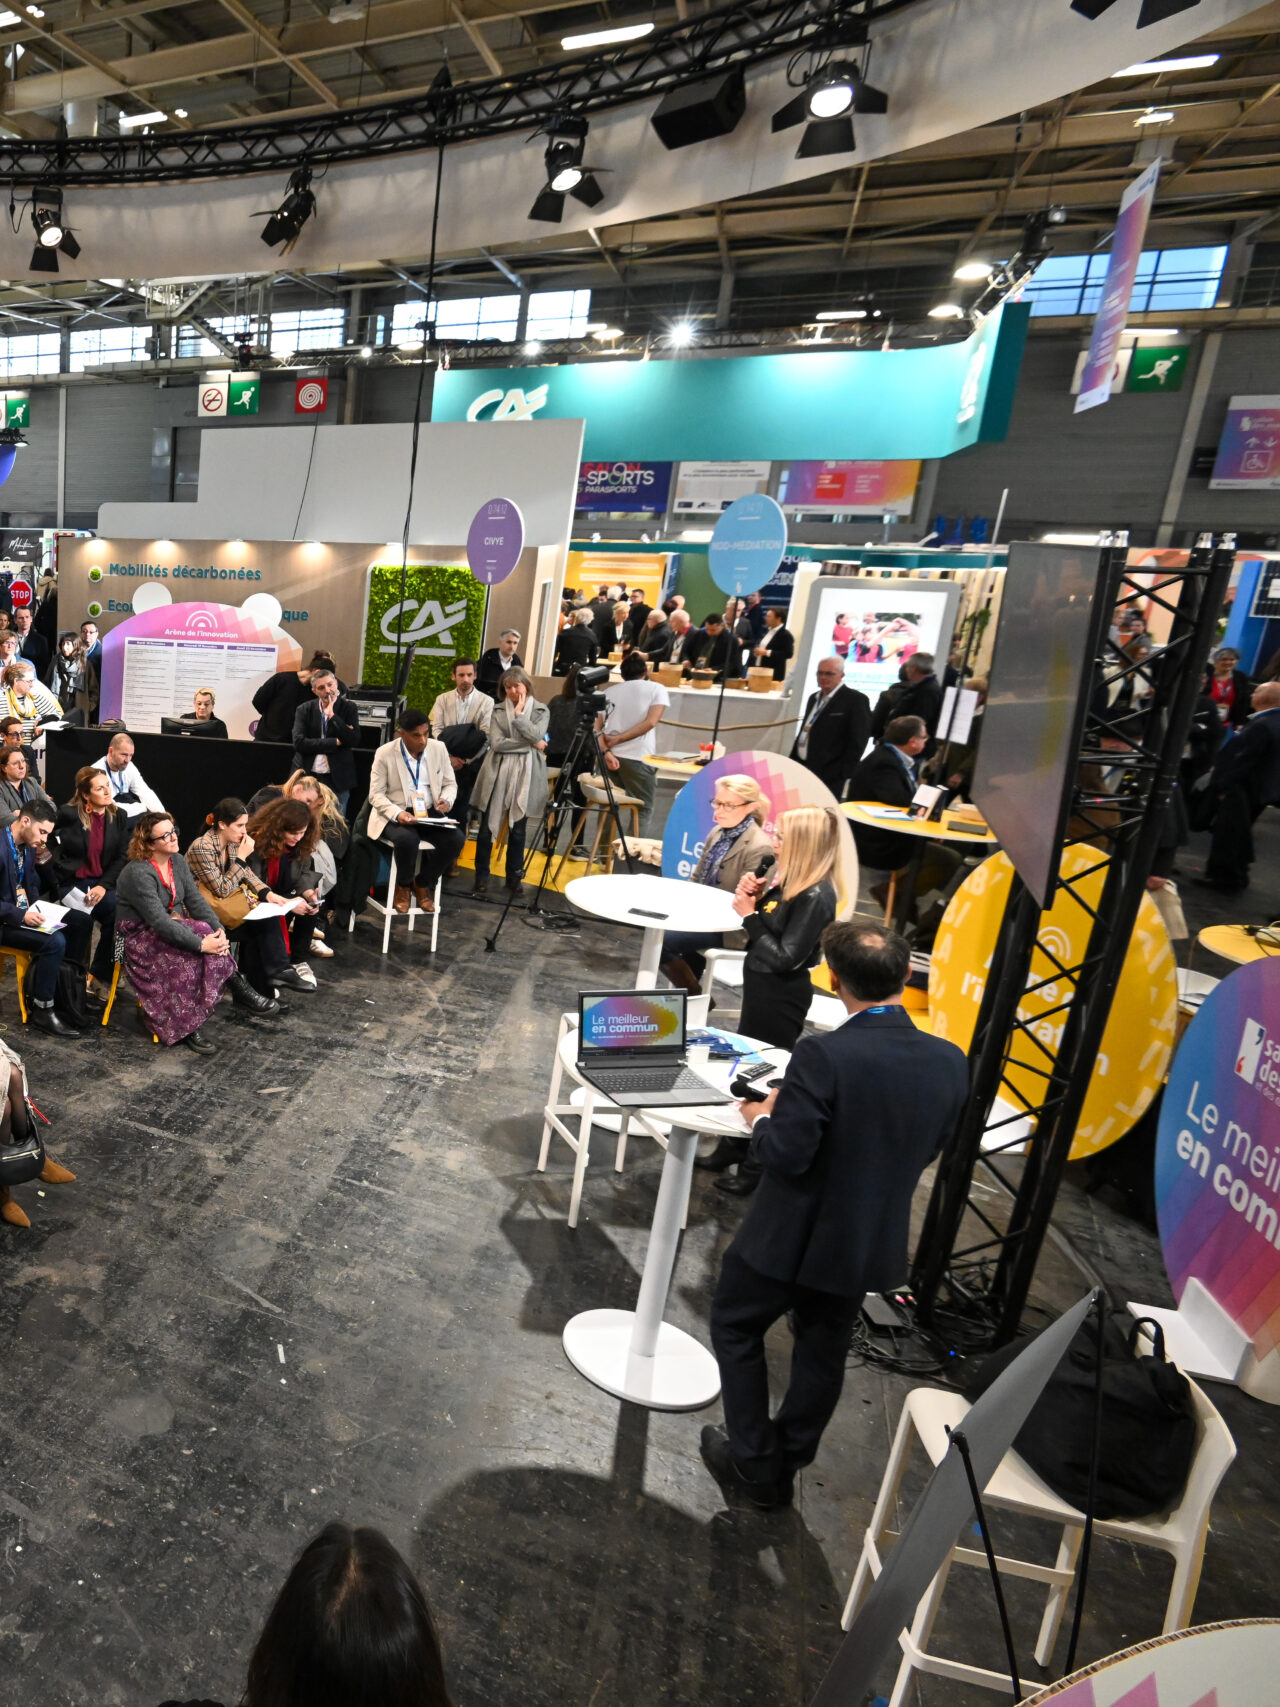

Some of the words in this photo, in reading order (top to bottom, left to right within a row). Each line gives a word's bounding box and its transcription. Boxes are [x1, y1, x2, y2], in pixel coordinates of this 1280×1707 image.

[587, 470, 655, 485] SPORTS
[585, 485, 638, 493] PARASPORTS
[110, 563, 168, 577] Mobilités
[172, 565, 261, 580] décarbonées
[164, 628, 185, 636] Arène
[187, 629, 195, 637] de
[196, 630, 238, 639] l'innovation
[592, 1014, 604, 1025] Le
[608, 1013, 650, 1025] meilleur
[592, 1025, 606, 1033] en
[609, 1024, 658, 1033] commun
[1186, 1081, 1219, 1134] Le
[1176, 1129, 1211, 1178] en
